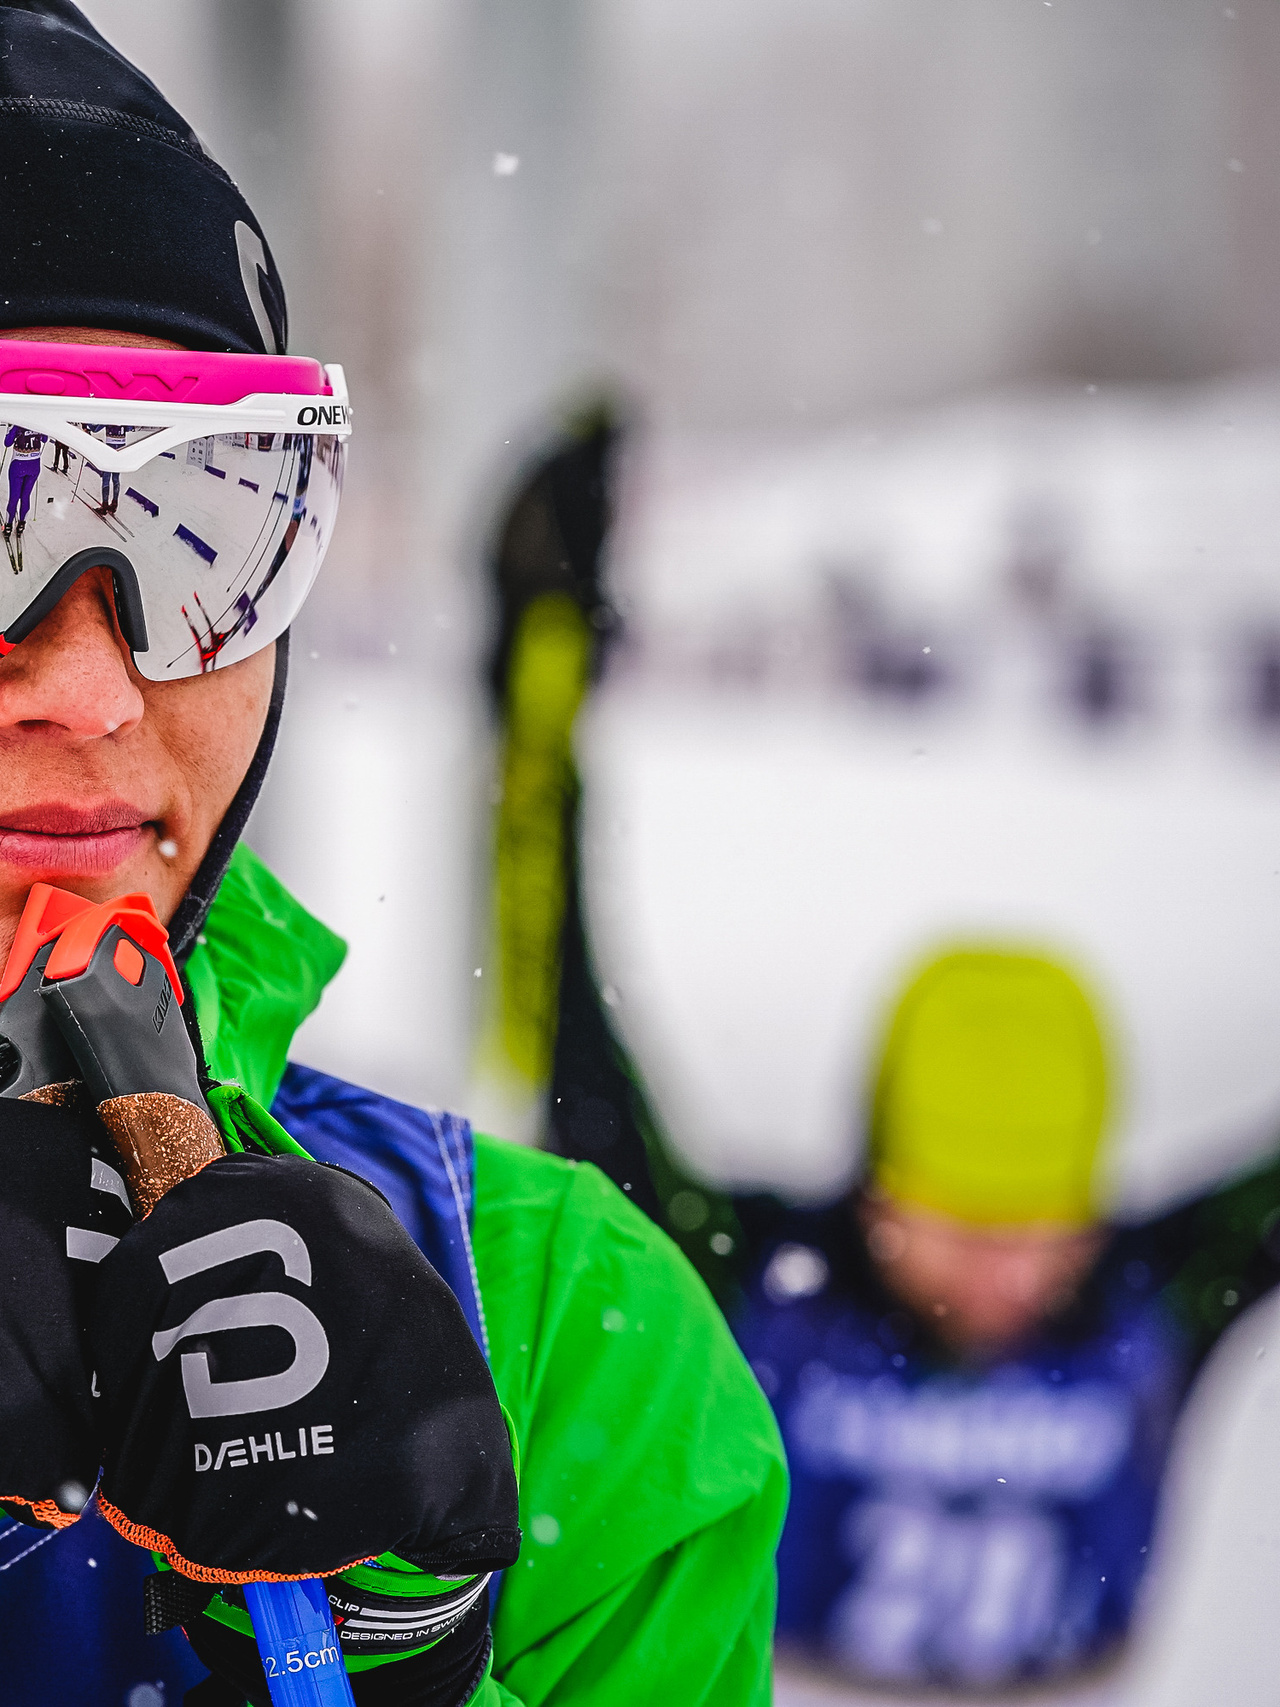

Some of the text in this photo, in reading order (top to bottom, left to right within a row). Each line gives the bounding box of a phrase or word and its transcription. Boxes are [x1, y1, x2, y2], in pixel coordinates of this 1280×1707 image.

[328, 1594, 360, 1612] CLIP
[340, 1630, 414, 1641] DESIGNED
[416, 1627, 430, 1638] IN
